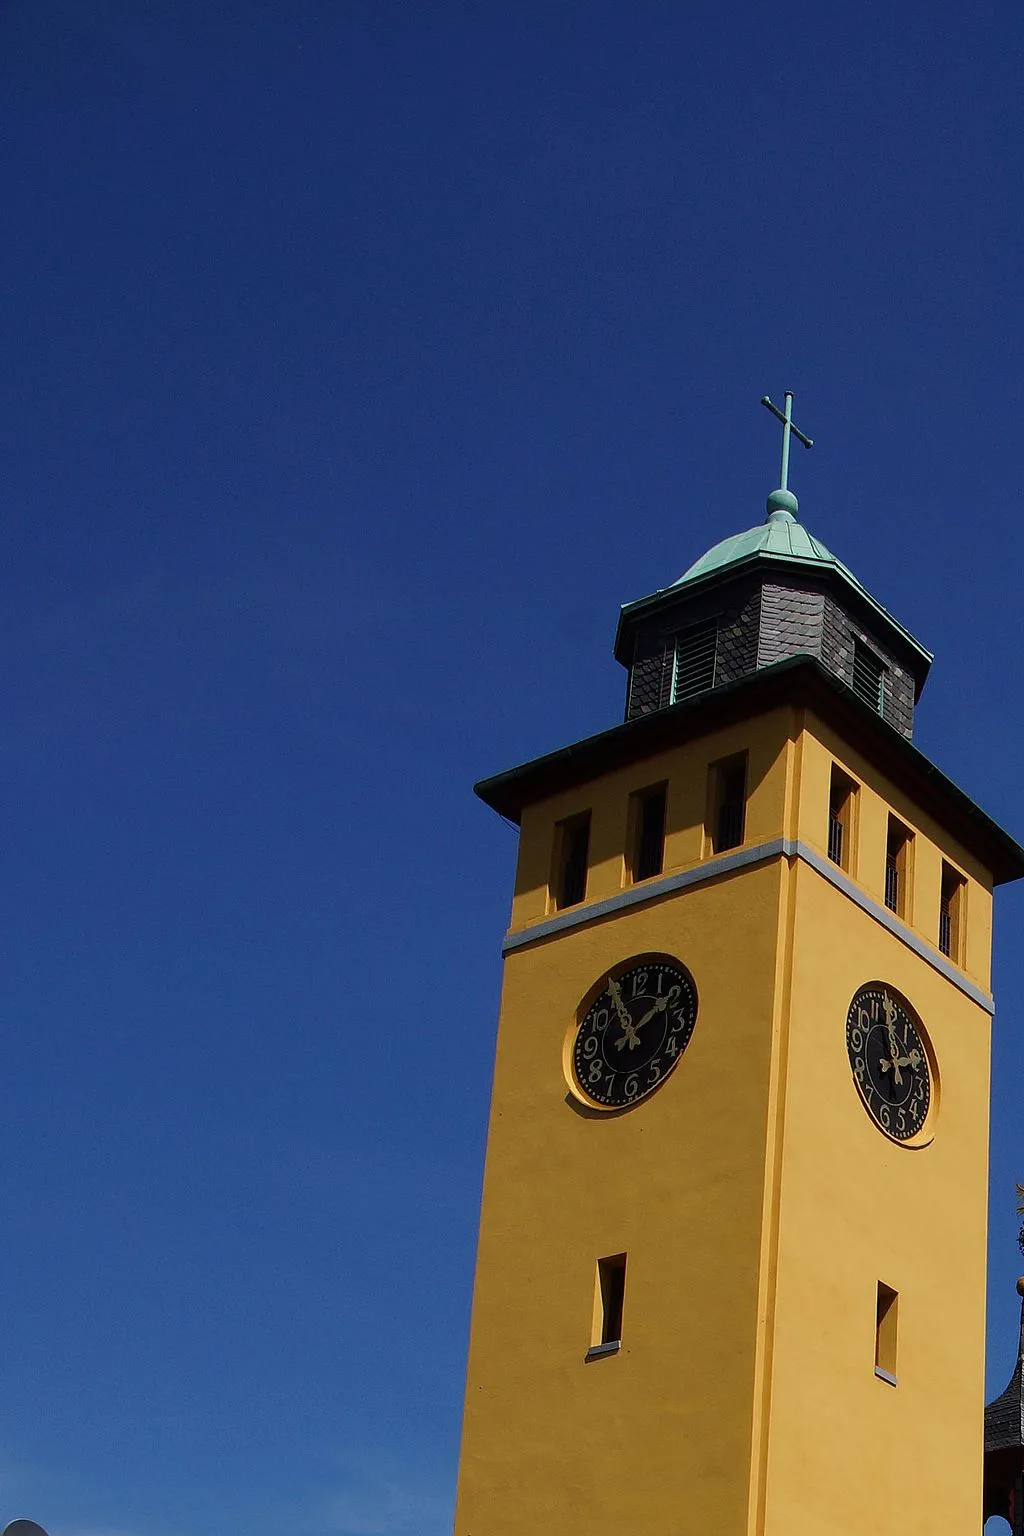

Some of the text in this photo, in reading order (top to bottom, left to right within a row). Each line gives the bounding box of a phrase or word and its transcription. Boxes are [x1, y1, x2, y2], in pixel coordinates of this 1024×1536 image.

[632, 972, 649, 997] 12
[656, 973, 663, 994] 1
[591, 1008, 609, 1033] 10
[672, 1007, 685, 1033] 3
[857, 1007, 870, 1033] 10
[583, 1036, 599, 1060] 9
[665, 1036, 678, 1057] 4
[850, 1028, 863, 1053] 9
[588, 1059, 603, 1083] 8
[647, 1058, 661, 1083] 5
[854, 1056, 865, 1082] 8
[605, 1074, 615, 1097] 7
[624, 1074, 638, 1097] 6
[865, 1084, 874, 1106] 7
[914, 1076, 925, 1101] 3
[879, 1103, 891, 1128] 6
[896, 1107, 906, 1132] 5
[909, 1099, 919, 1121] 4
